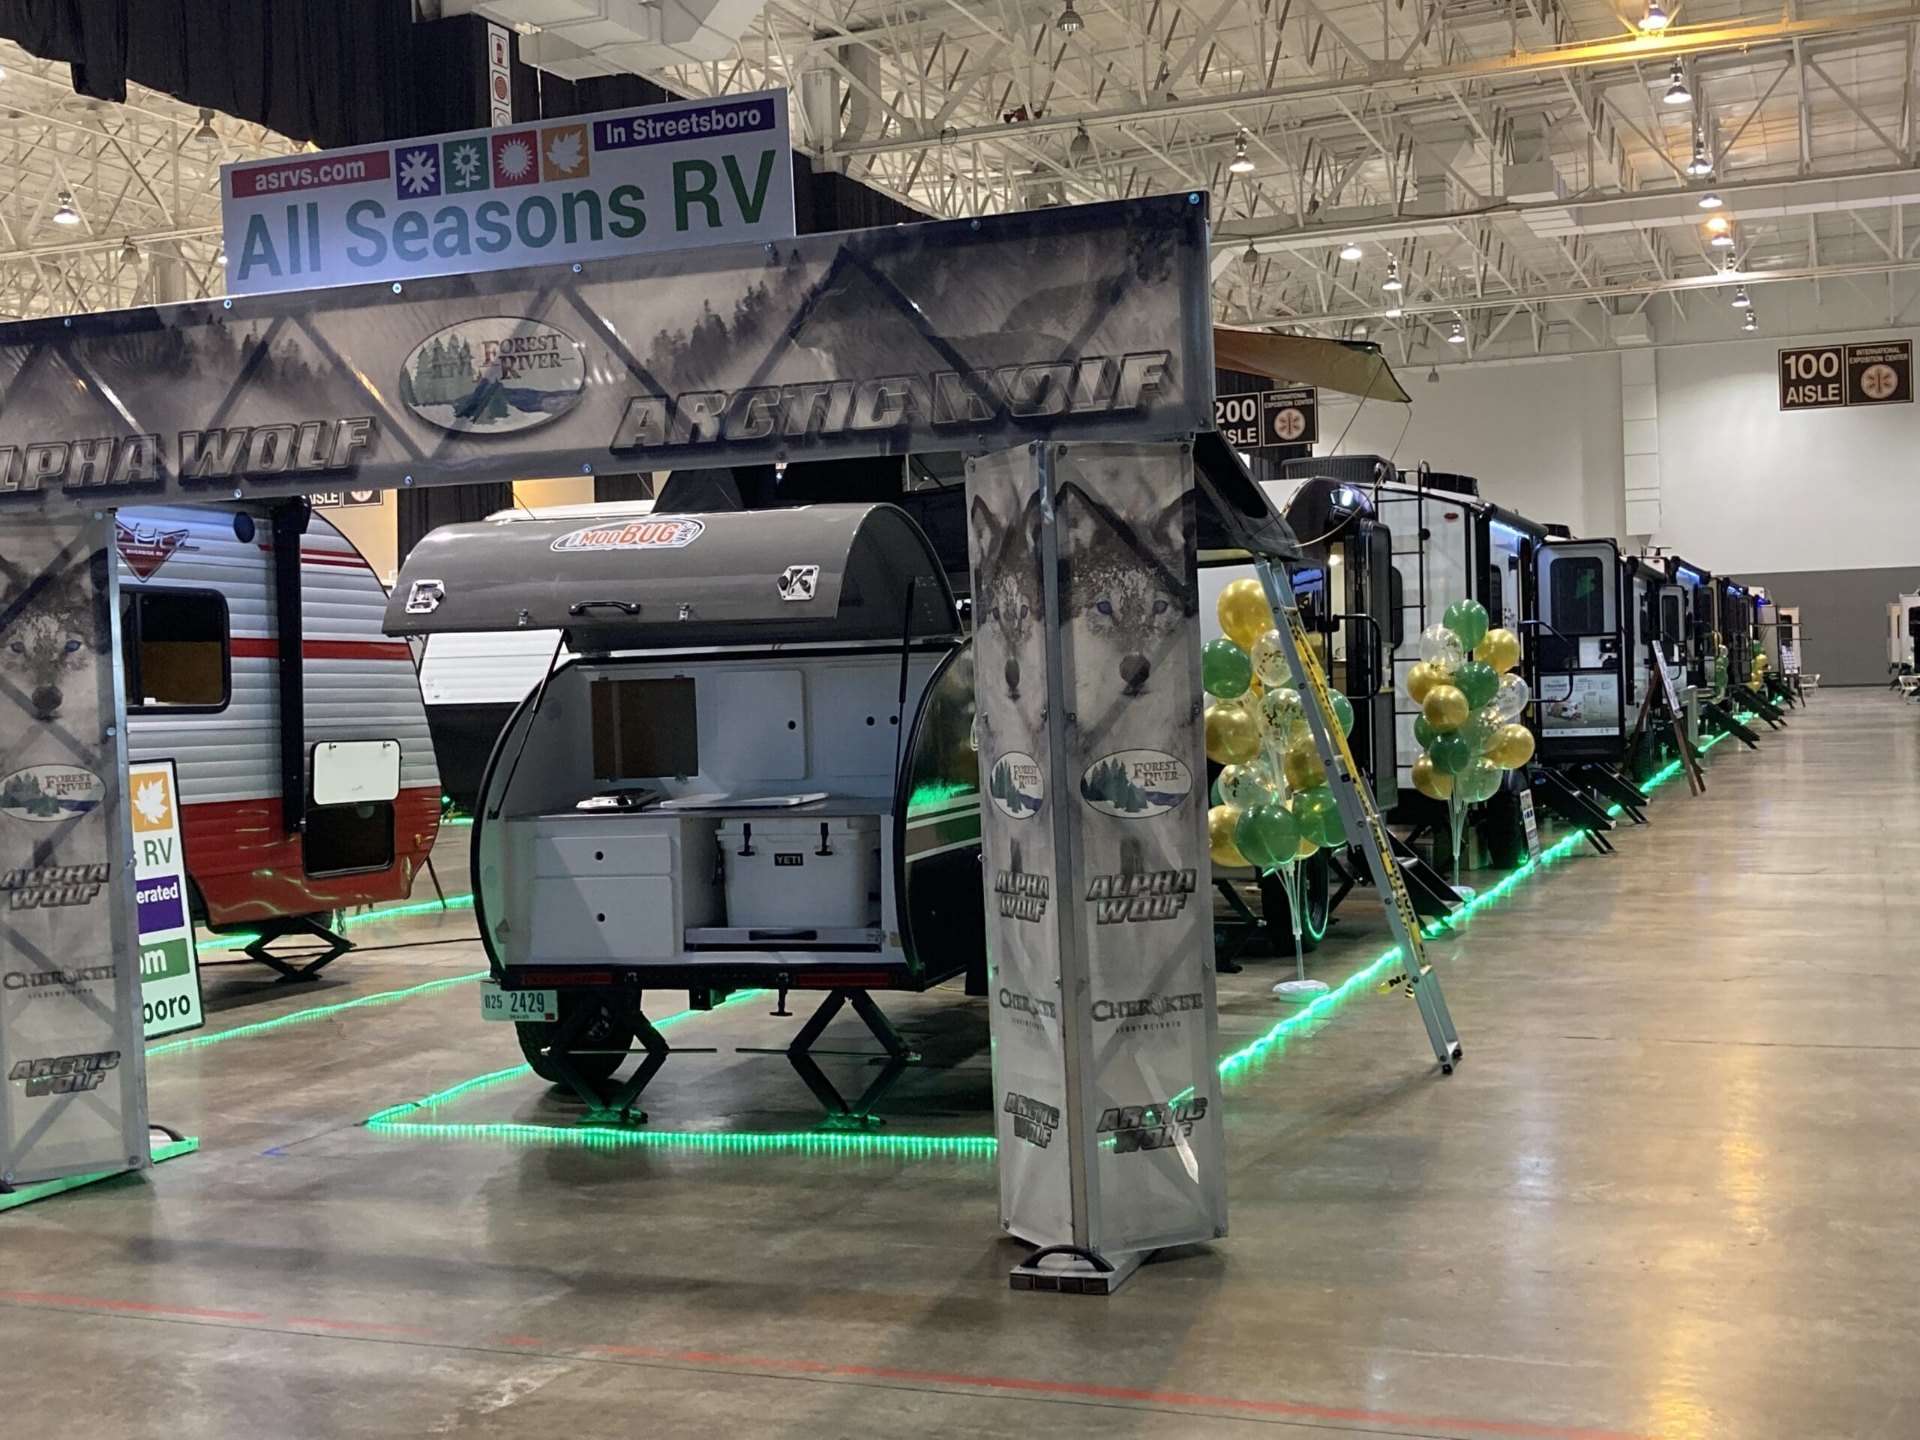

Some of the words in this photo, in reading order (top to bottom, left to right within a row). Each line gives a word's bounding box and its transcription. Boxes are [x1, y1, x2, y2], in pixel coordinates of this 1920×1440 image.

[606, 123, 627, 144] In
[632, 109, 762, 140] Streetsboro
[254, 159, 366, 191] asrvs.com
[237, 202, 321, 280] All
[345, 184, 647, 268] Seasons
[672, 149, 776, 232] RV
[479, 335, 562, 367] FOREST
[499, 352, 562, 379] RIVER
[1784, 352, 1839, 380] 100
[610, 377, 911, 454] ARCTIC
[930, 350, 1173, 428] WOLF
[1786, 383, 1840, 404] AISLE
[1216, 399, 1256, 424] 200
[1222, 427, 1257, 444] SLE
[0, 433, 162, 492] LPHA
[178, 417, 378, 486] WOLF
[309, 492, 339, 505] ISLE
[45, 774, 92, 789] FOREST
[1013, 765, 1037, 780] FOREST
[1018, 775, 1037, 789] RIVER
[1133, 761, 1178, 779] FOREST
[1143, 771, 1178, 787] RIVER
[56, 782, 92, 796] RIVER
[144, 837, 173, 866] RV
[776, 855, 802, 865] YETI
[0, 863, 110, 890] ALPHA
[995, 870, 1049, 900] ALPHA
[1085, 868, 1197, 901] ALPHA
[10, 883, 101, 910] WOLF
[137, 882, 179, 904] erated
[1000, 895, 1046, 923] WOLF
[1097, 894, 1187, 925] WOLF
[144, 994, 190, 1024] boro
[510, 993, 545, 1013] 2429
[8, 1051, 121, 1081] ARCTIC
[26, 1070, 106, 1097] WOLF
[1005, 1092, 1060, 1130] ARCTIC
[1097, 1097, 1208, 1133] ARCTIC
[1014, 1115, 1053, 1149] WOLF
[1114, 1122, 1188, 1154] WOLF
